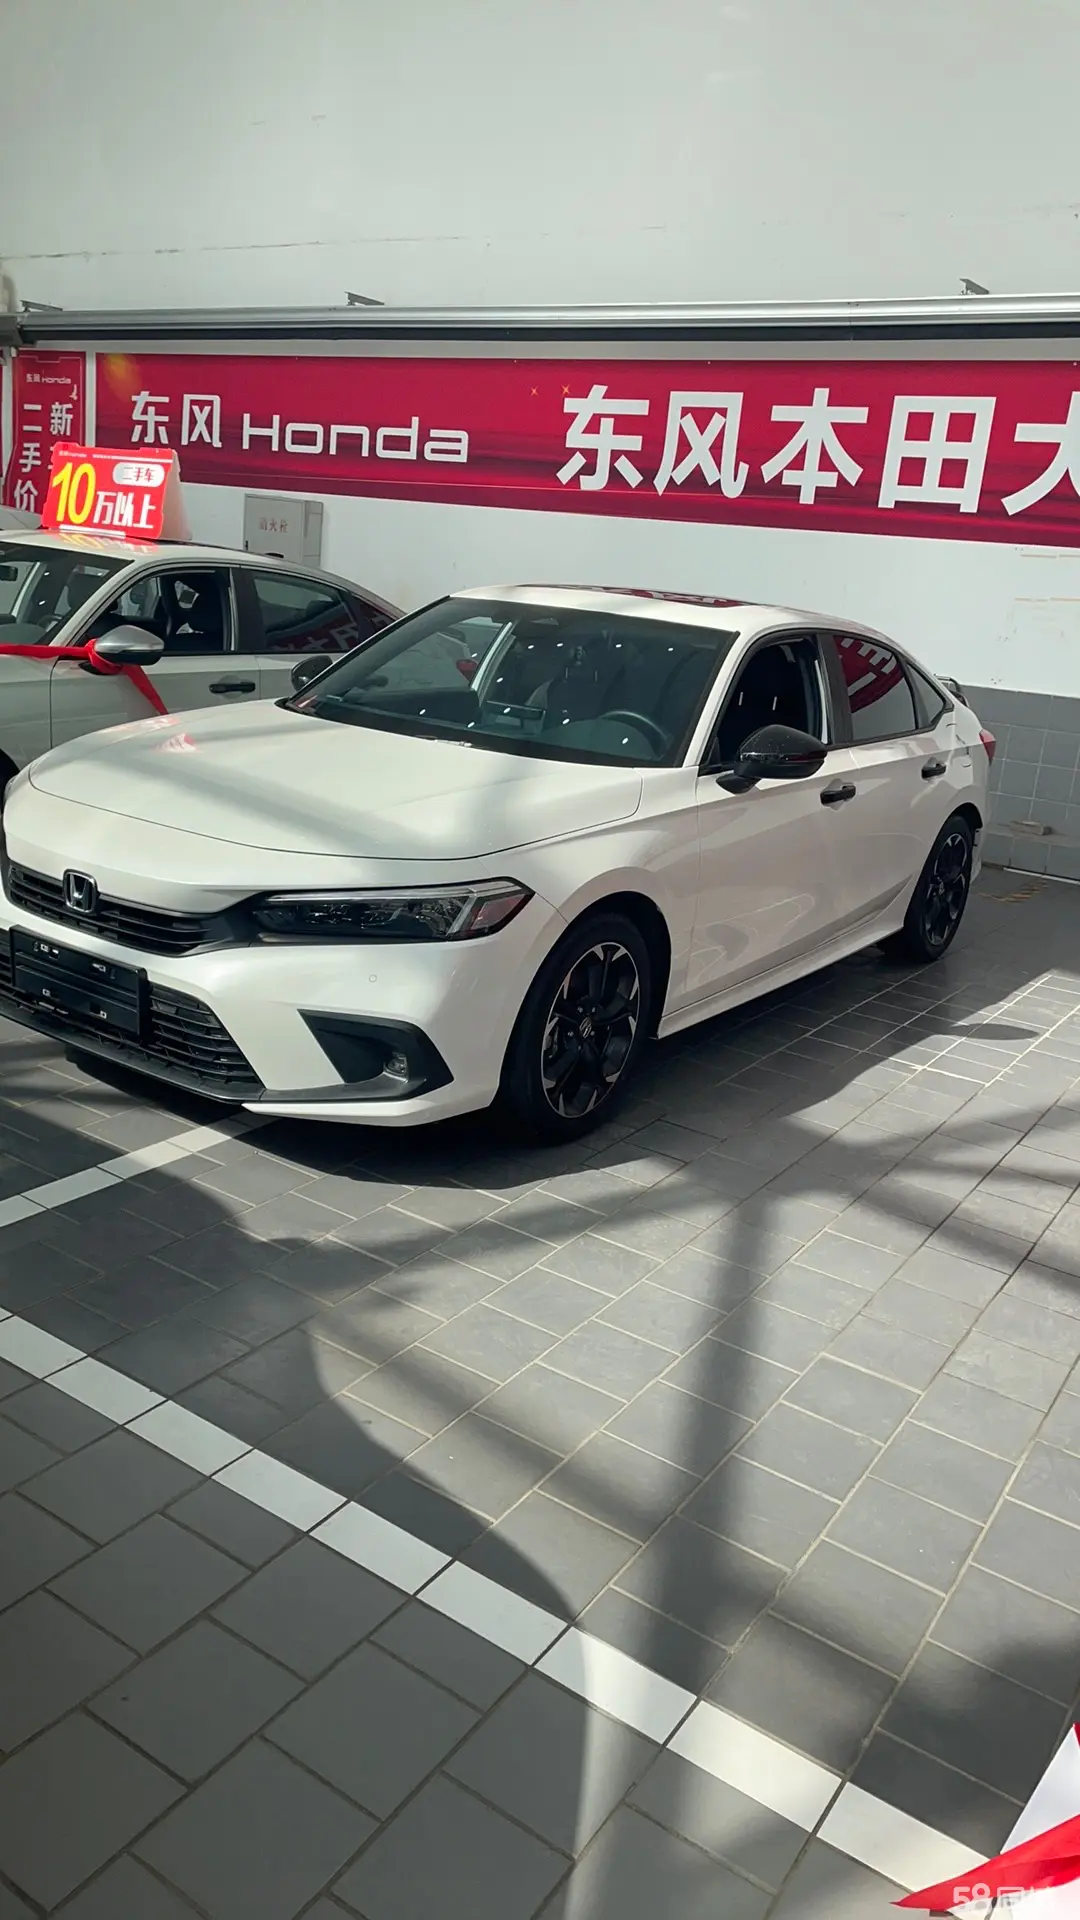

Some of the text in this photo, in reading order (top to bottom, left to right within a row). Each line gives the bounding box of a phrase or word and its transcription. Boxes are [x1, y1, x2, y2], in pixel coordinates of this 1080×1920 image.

[131, 391, 469, 463] 东风 Honda
[52, 462, 156, 528] 10万以上
[123, 466, 155, 482] 二手车
